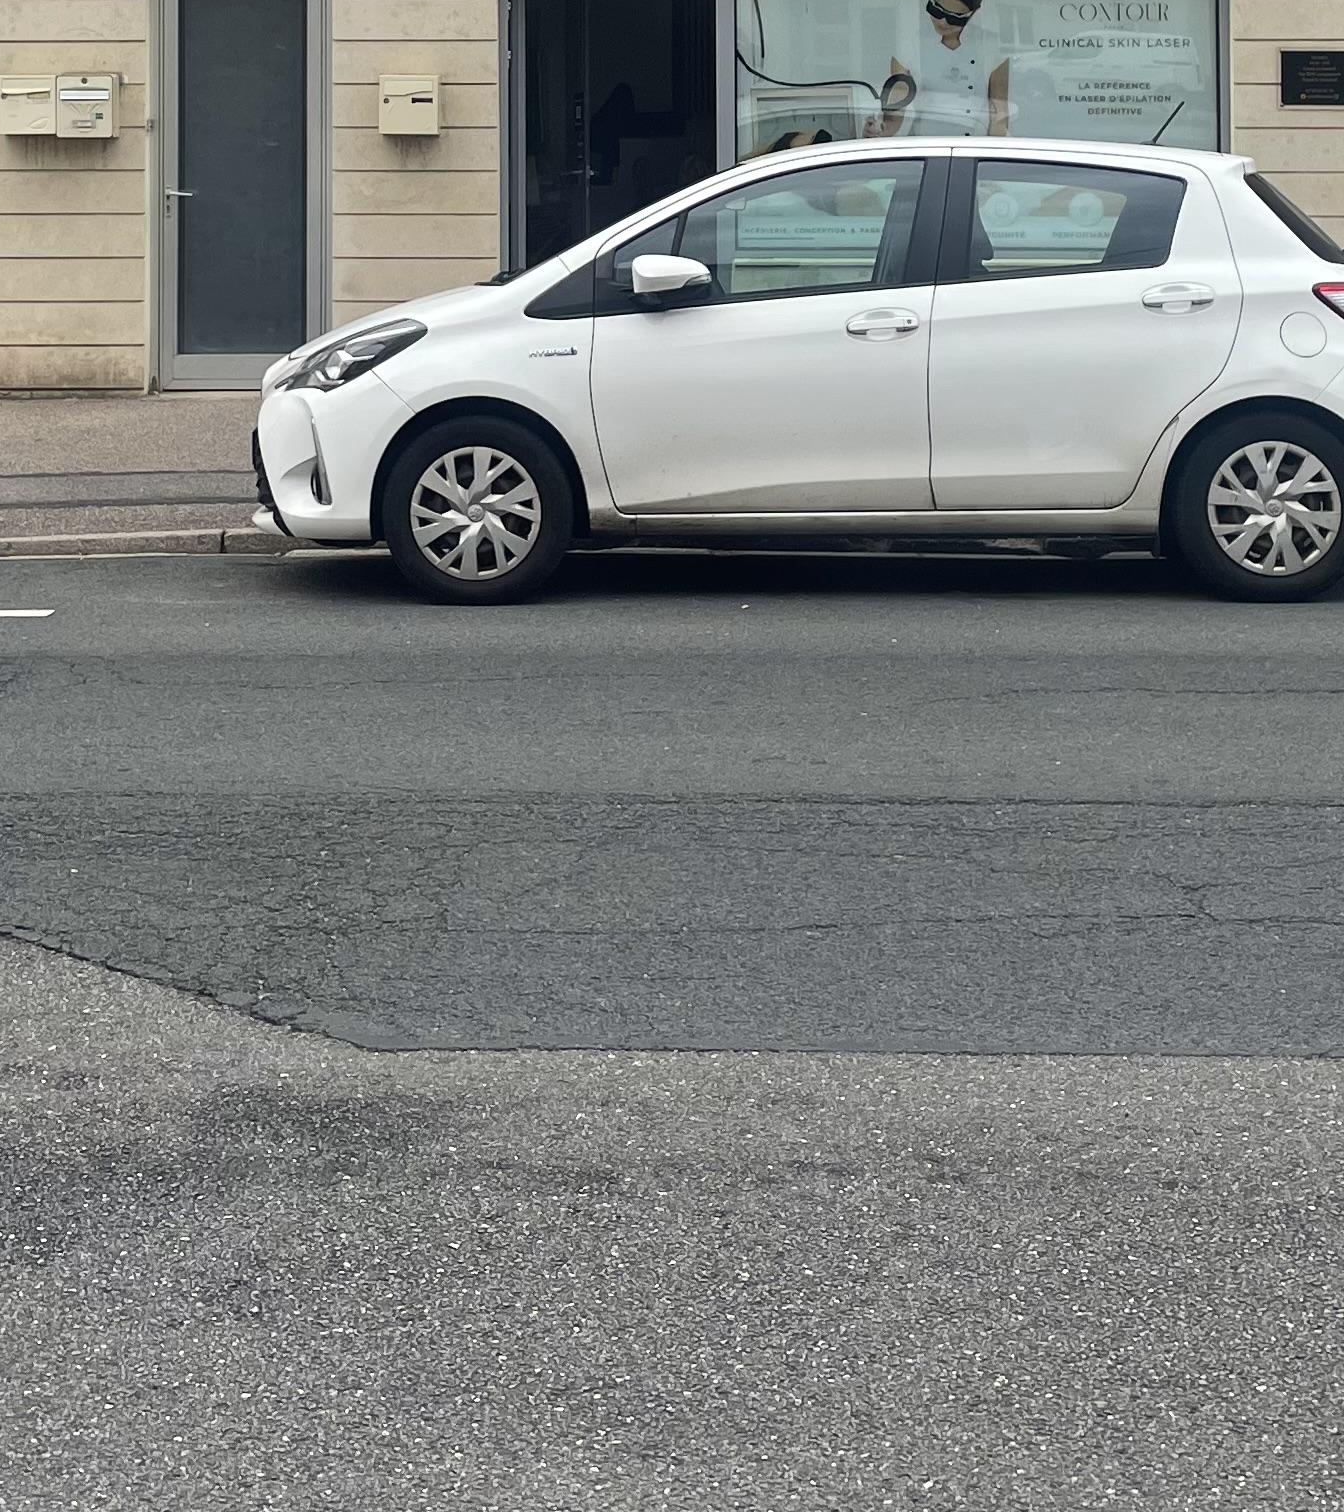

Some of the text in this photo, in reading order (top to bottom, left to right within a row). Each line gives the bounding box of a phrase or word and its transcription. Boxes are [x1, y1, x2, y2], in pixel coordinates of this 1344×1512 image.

[1059, 2, 1169, 22] CONTOUR
[1038, 38, 1191, 48] CLINICAL SKIN LASER
[1078, 82, 1091, 90] LA
